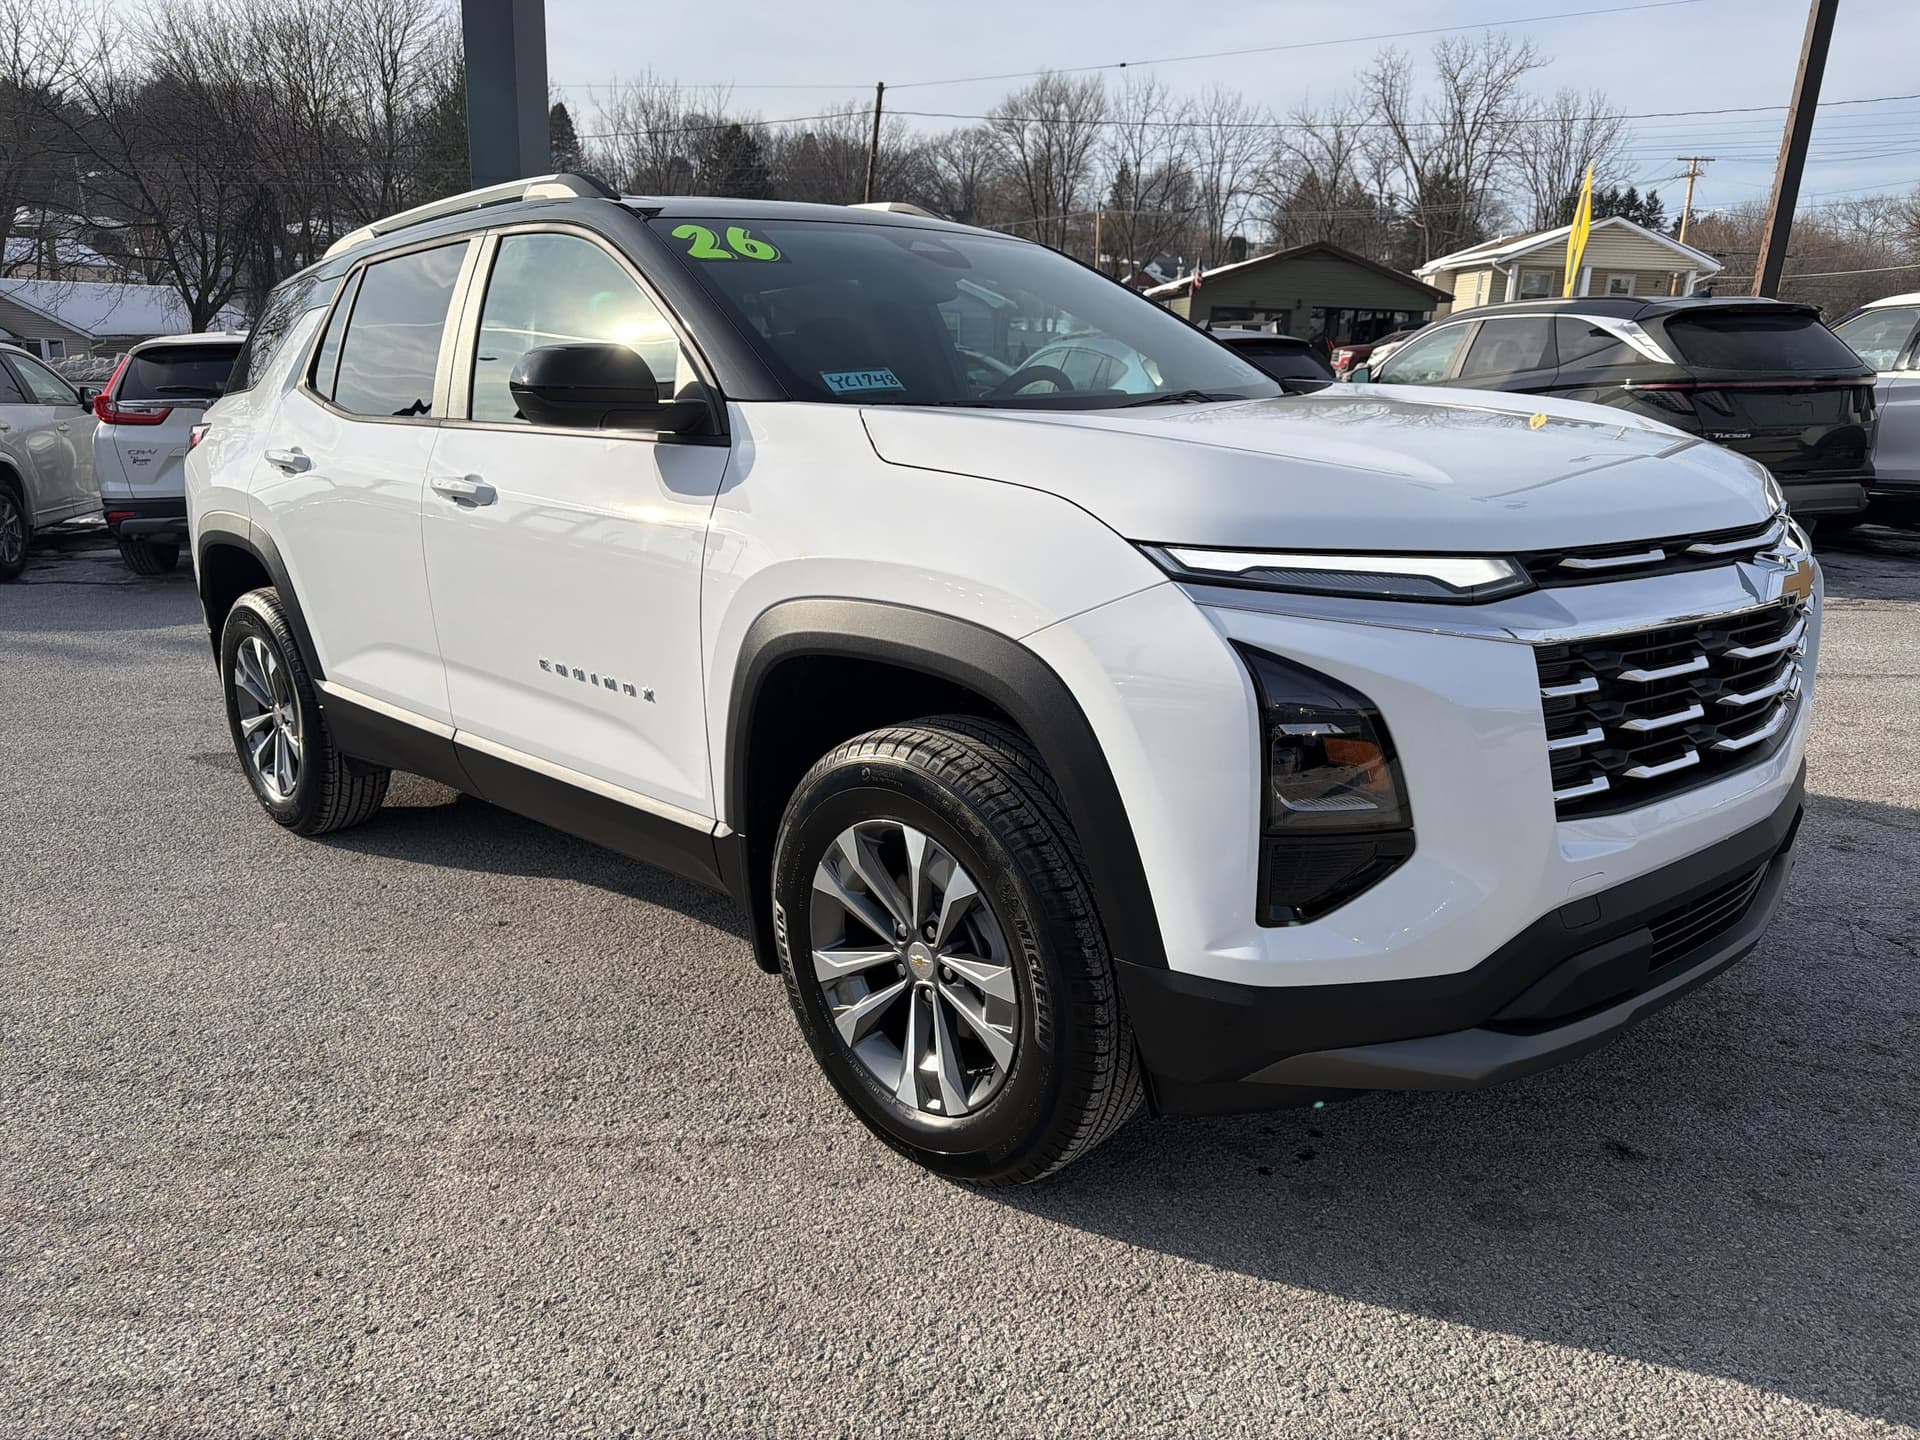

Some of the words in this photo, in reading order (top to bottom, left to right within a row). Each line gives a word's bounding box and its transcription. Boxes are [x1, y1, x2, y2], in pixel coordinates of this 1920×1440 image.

[672, 224, 781, 261] 26
[538, 658, 656, 704] EQUINOX
[1015, 919, 1050, 1047] MICHELIN
